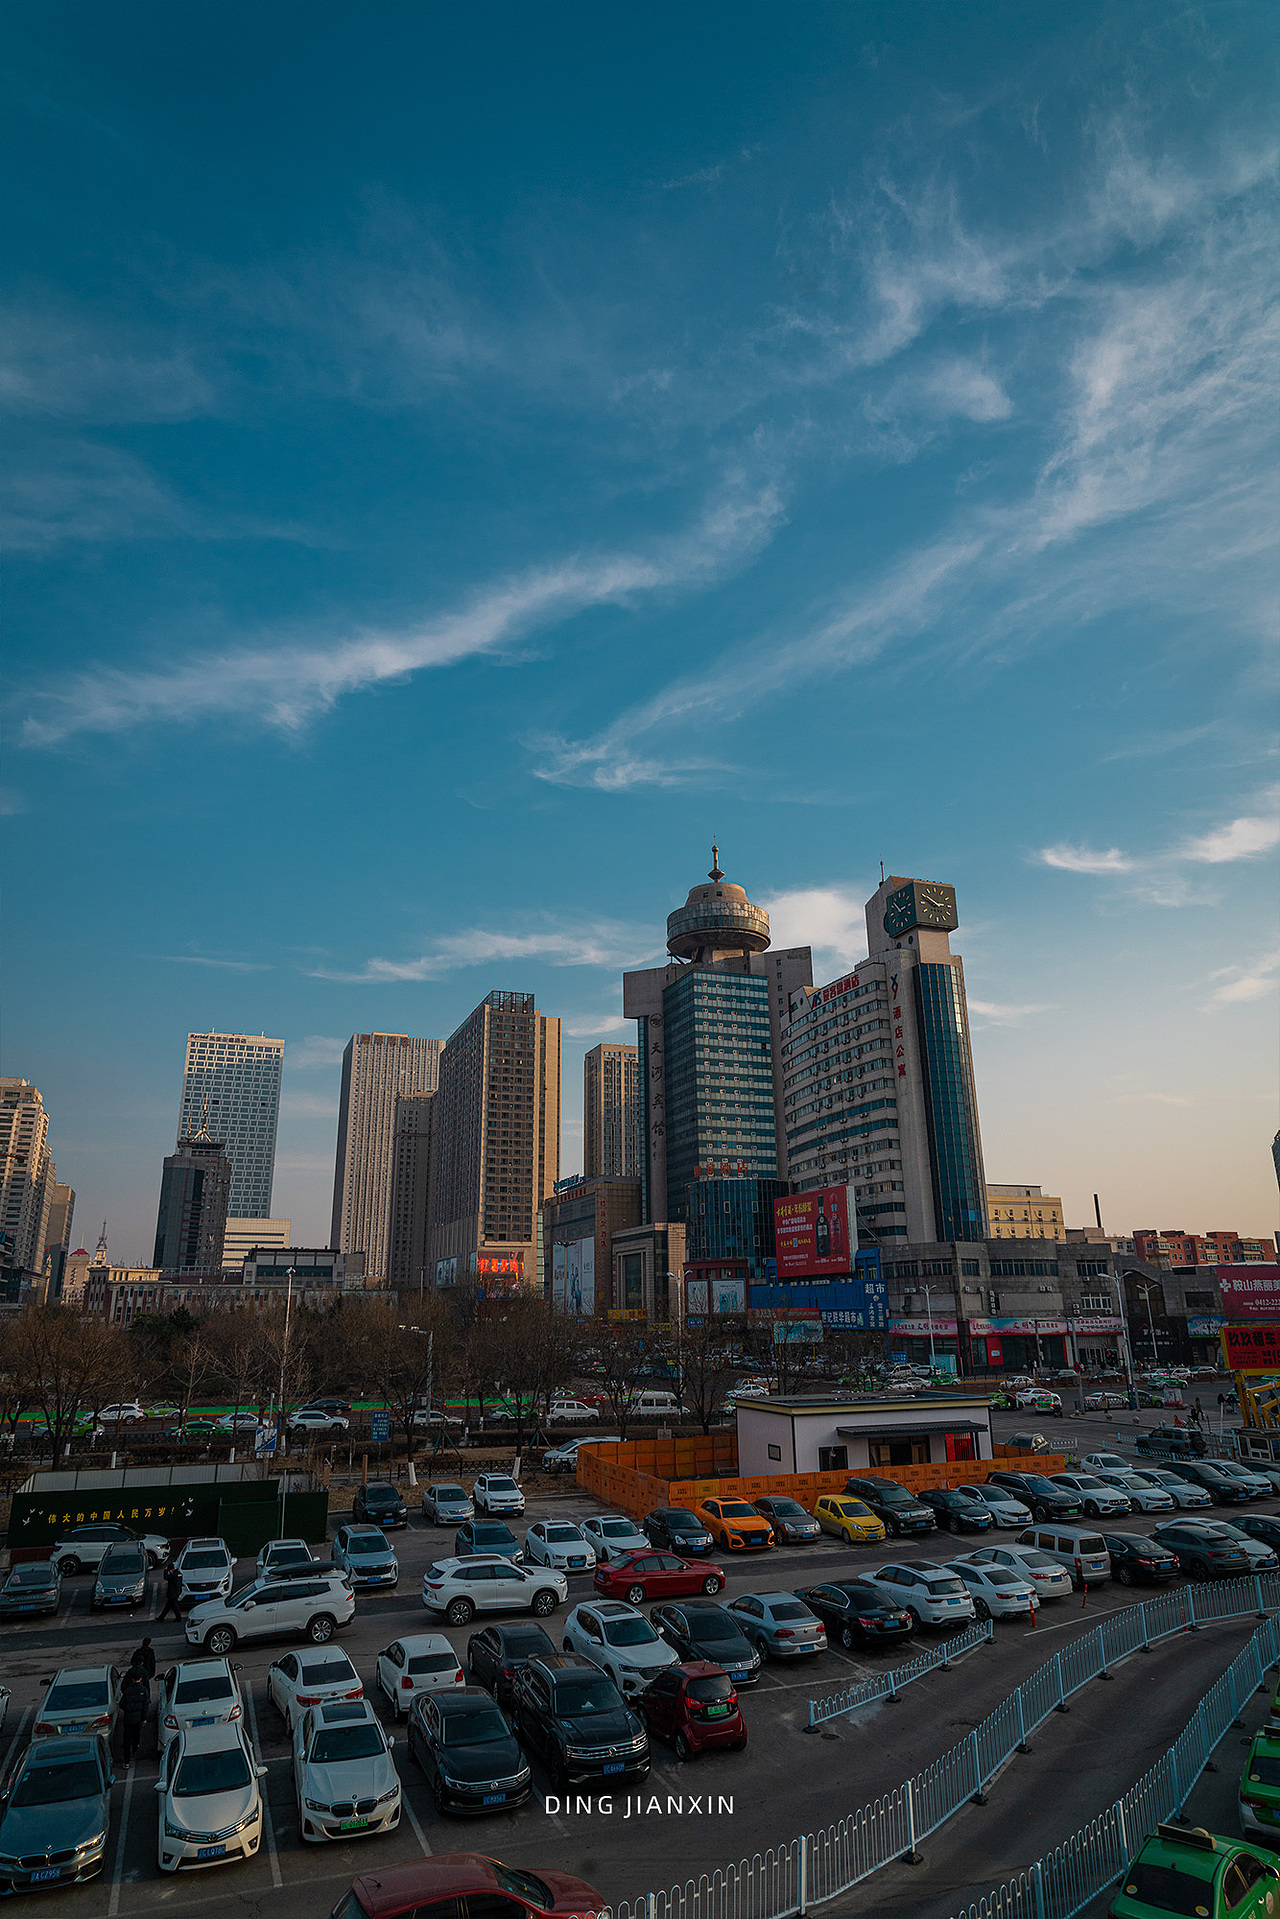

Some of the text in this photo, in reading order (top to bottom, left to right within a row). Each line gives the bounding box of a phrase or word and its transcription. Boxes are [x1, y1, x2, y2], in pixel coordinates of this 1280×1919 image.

[893, 1005, 906, 1077] 酒店公寓
[865, 1282, 886, 1294] 超市
[1228, 1332, 1277, 1347] 玖玖租车
[48, 1506, 175, 1524] 伟大的中国人民万岁！
